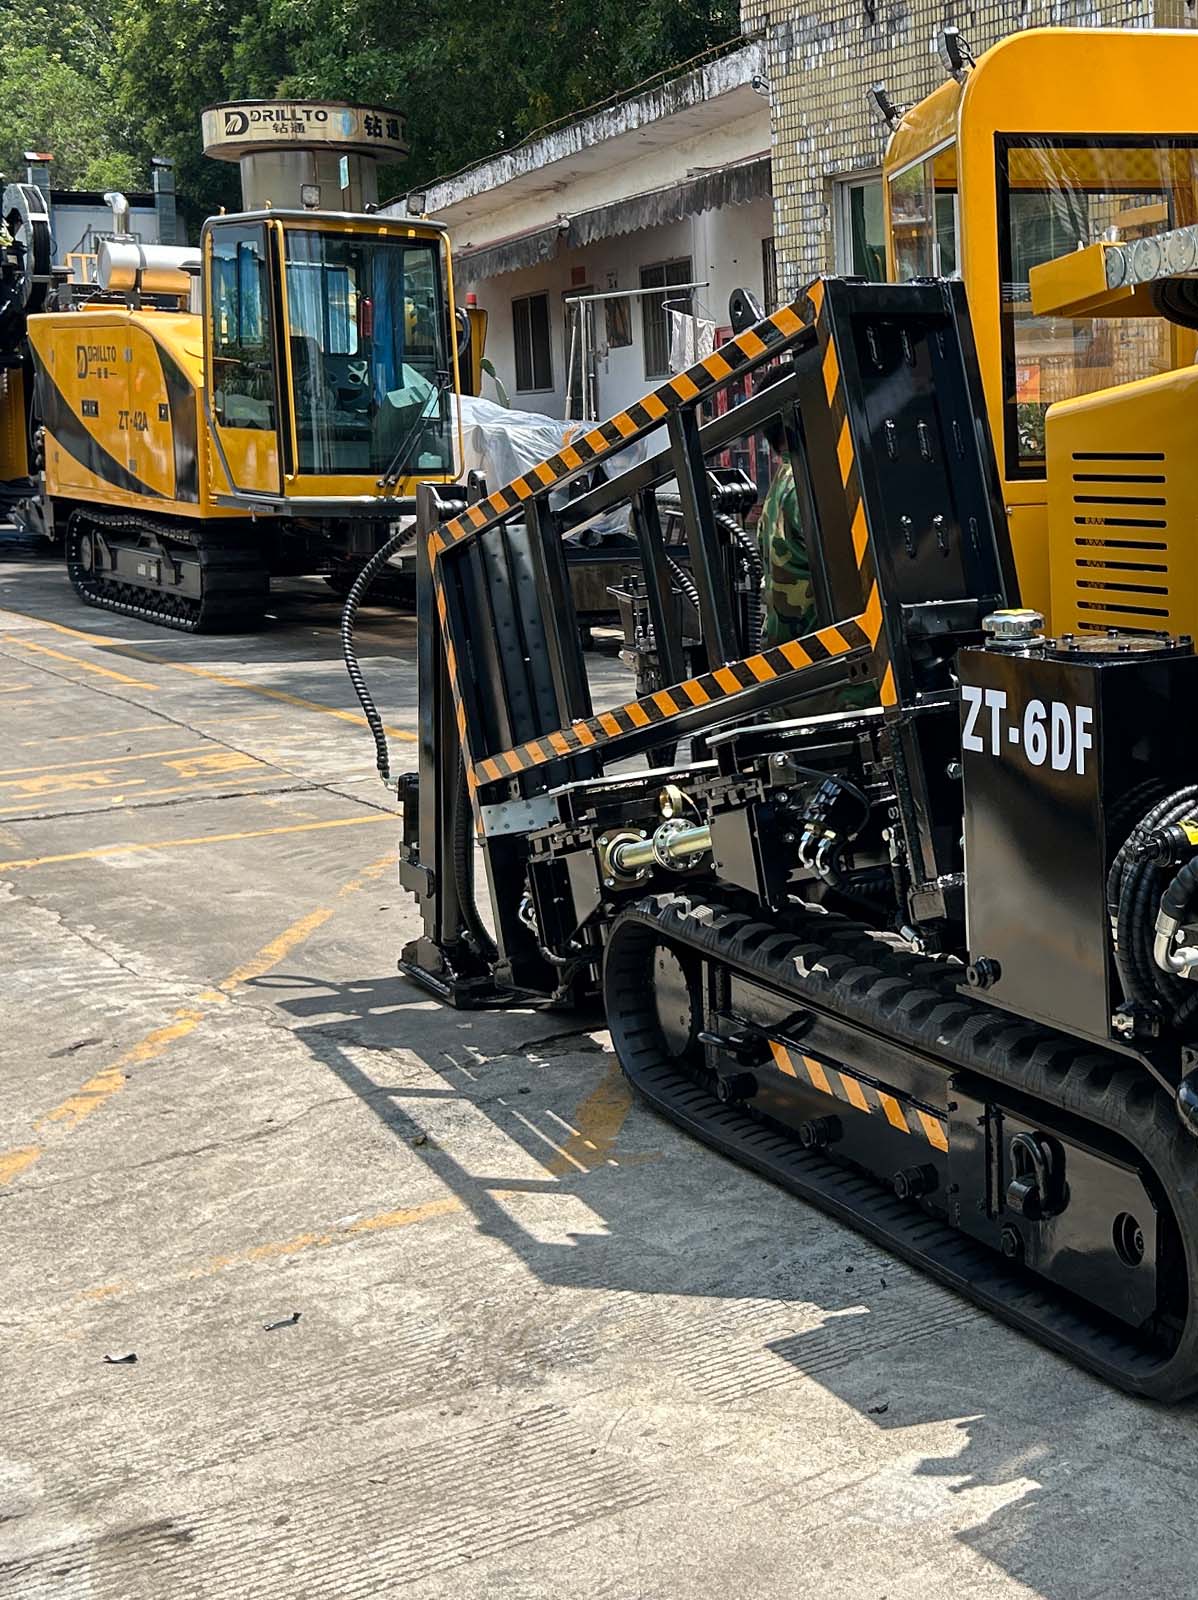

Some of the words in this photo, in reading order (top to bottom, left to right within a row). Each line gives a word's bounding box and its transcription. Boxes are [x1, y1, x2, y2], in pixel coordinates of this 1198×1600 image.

[250, 110, 328, 122] DRILLTO
[272, 122, 305, 134] 钻通
[364, 114, 406, 142] 钻通
[88, 346, 116, 362] DRILLTO
[962, 685, 1093, 775] ZT-6DF
